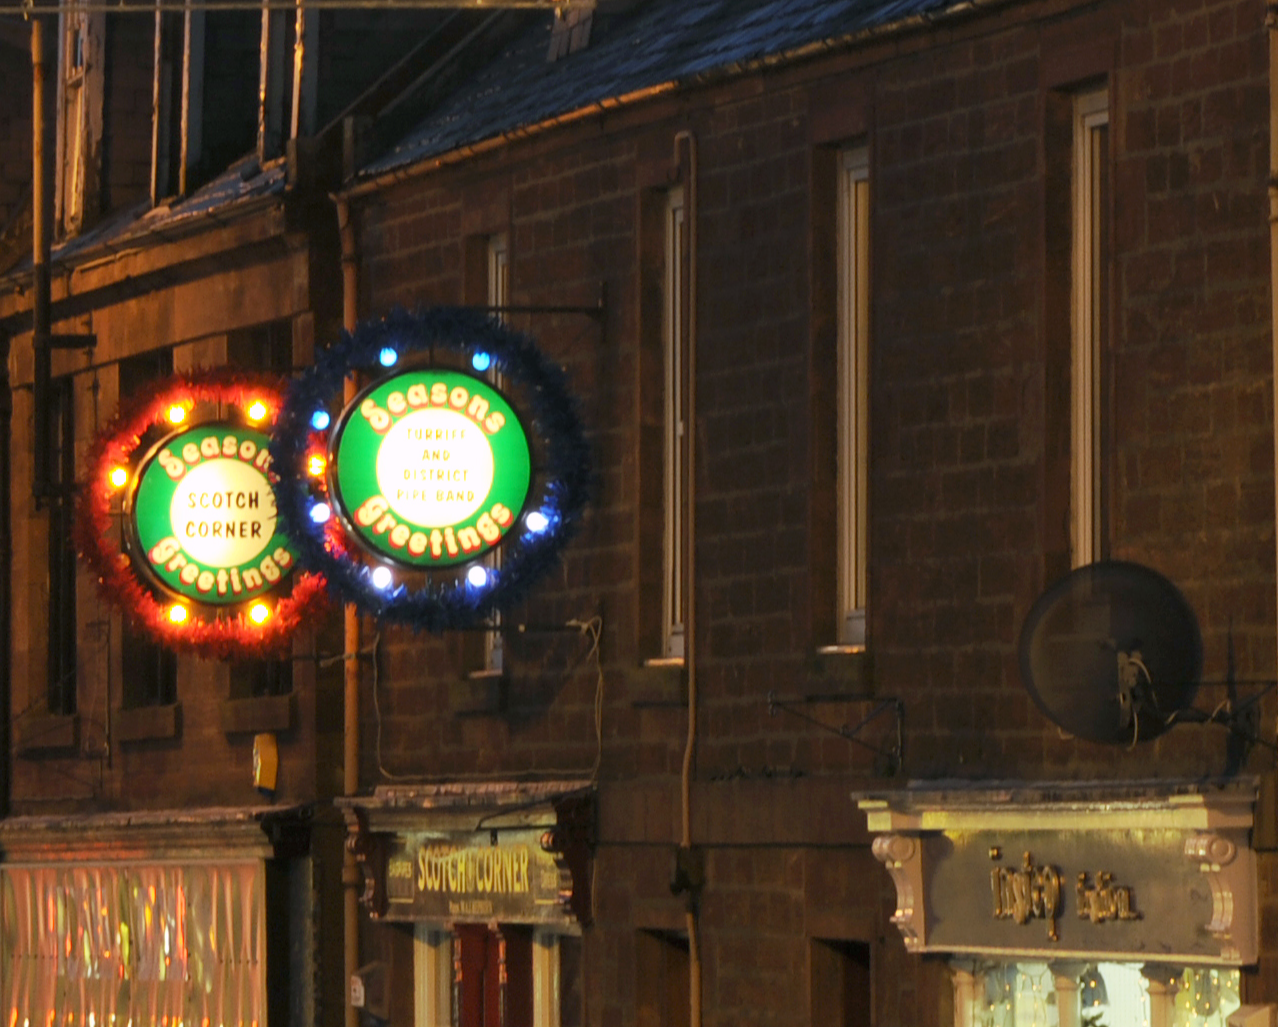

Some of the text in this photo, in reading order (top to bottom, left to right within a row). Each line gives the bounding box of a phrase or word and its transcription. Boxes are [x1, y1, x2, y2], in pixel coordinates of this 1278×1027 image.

[360, 382, 507, 436] Seasons
[407, 428, 466, 440] TURRIFF
[157, 435, 281, 484] Season
[422, 449, 451, 461] AND
[403, 469, 470, 482] DISTRICT
[187, 490, 260, 509] SCOTCH
[396, 489, 476, 502] PIPE BAND
[185, 520, 262, 539] CORNER
[353, 494, 515, 560] Greetings
[147, 536, 294, 596] Greetings
[417, 844, 467, 893] SCOTCH
[475, 845, 530, 894] CORNER
